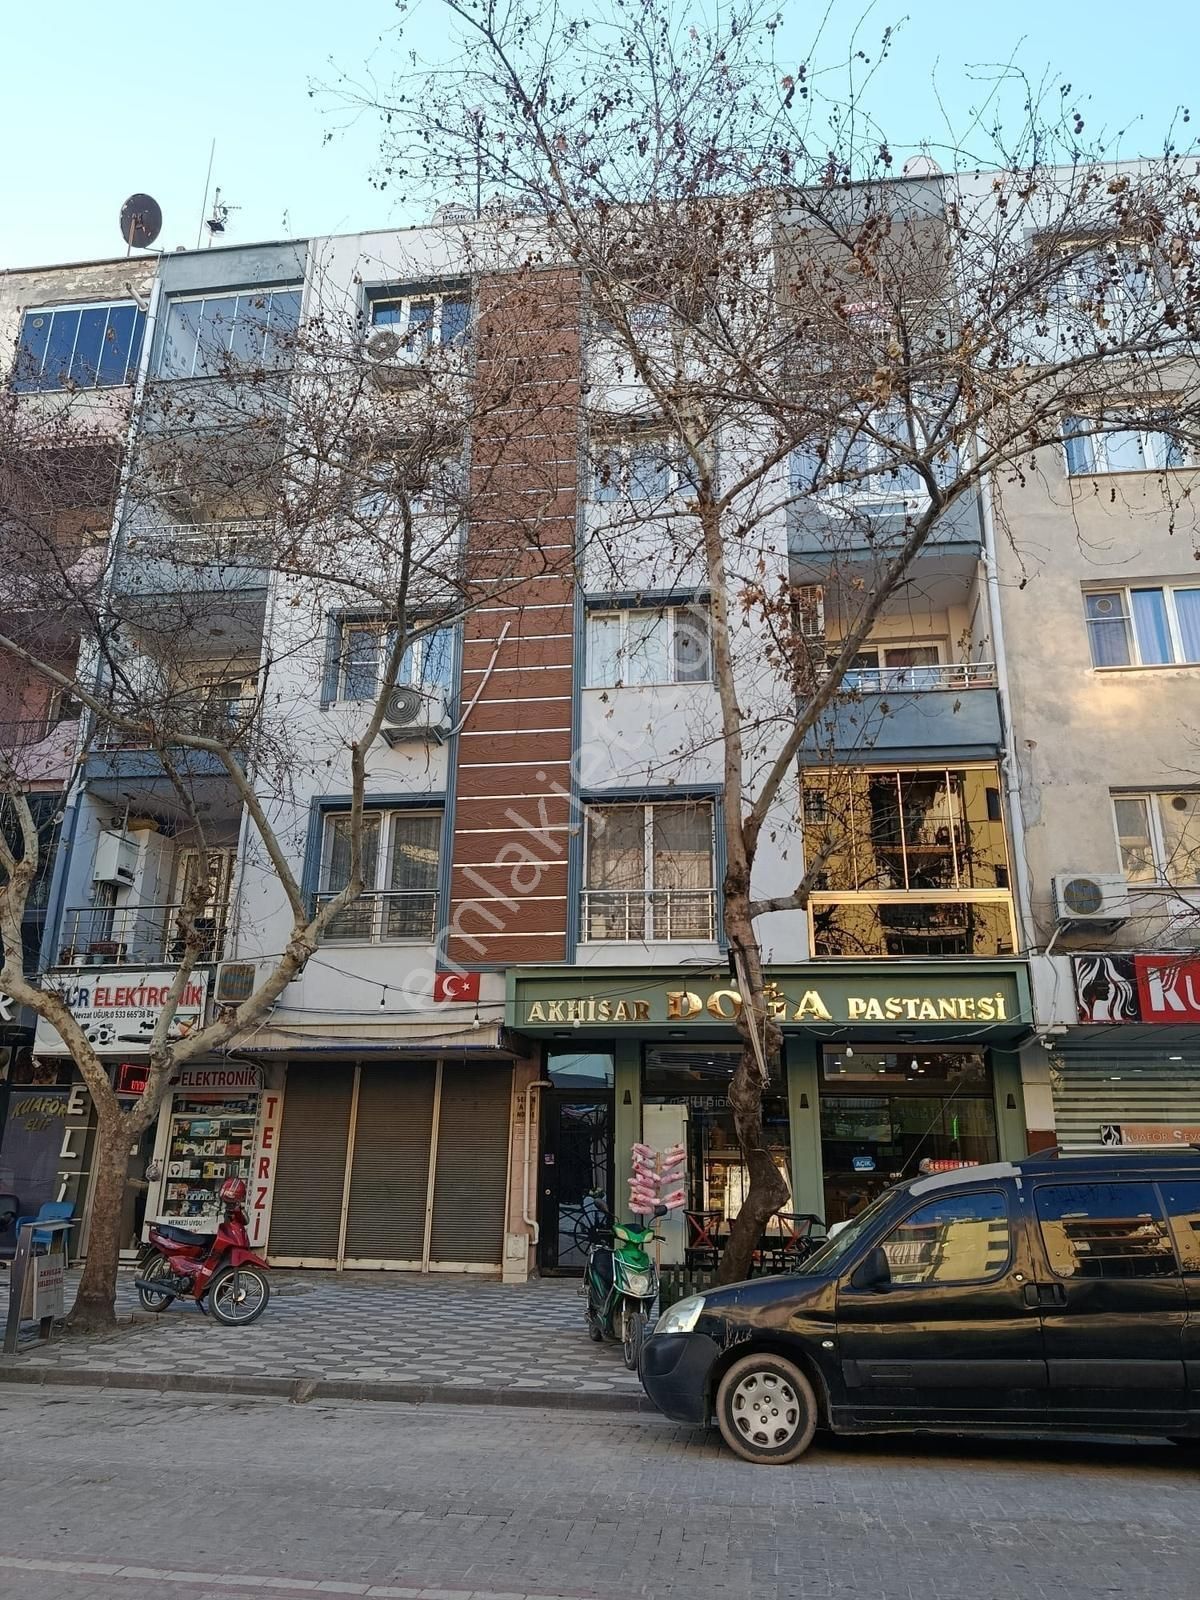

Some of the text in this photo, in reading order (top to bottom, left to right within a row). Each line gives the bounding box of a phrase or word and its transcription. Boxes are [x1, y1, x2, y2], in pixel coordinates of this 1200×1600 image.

[115, 1010, 126, 1018] 533
[527, 996, 651, 1022] AKHİSAR
[847, 992, 1007, 1021] PASTANESİ
[181, 1065, 257, 1087] ELEKTRONİK
[253, 1097, 278, 1240] TERZİ
